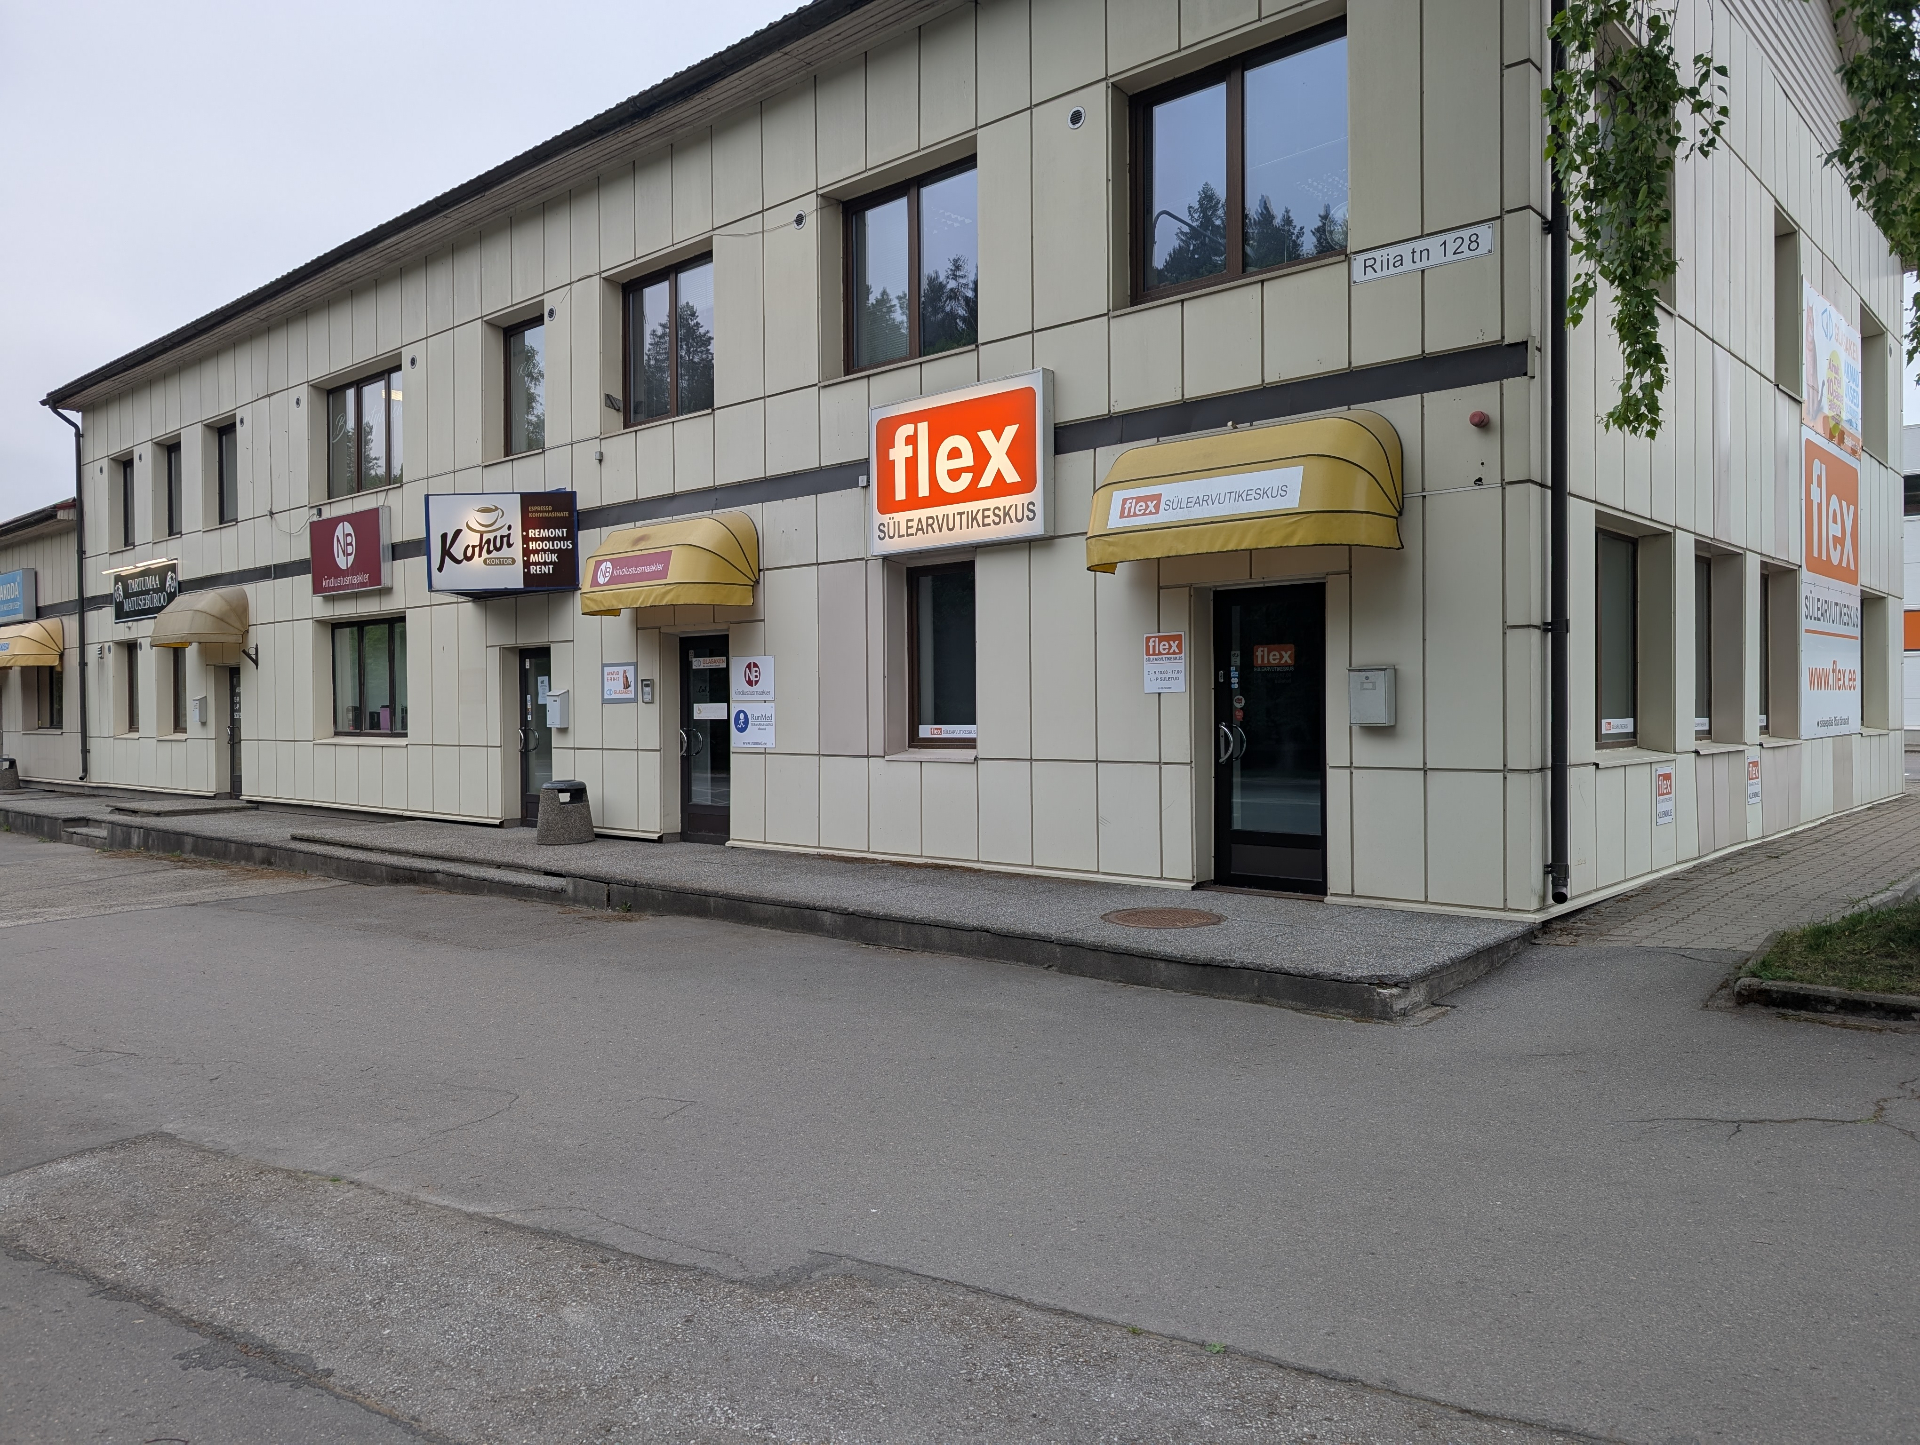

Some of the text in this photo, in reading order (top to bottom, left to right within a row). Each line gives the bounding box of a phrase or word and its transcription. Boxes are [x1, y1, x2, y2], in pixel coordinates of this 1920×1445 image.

[1363, 232, 1480, 276] Riia tn 128
[888, 421, 1022, 501] flex
[1123, 484, 1288, 517] flex SÜLEARVUTIKESKUS
[877, 501, 1037, 541] SÜLEARVUTIKESKUS
[1810, 458, 1855, 571] flex
[528, 528, 568, 538] REMONT
[436, 524, 515, 573] Kohvi
[528, 540, 573, 550] HOOLDUS
[529, 551, 559, 563] MÜÜK
[530, 565, 554, 574] RENT
[127, 574, 161, 593] TARTUMAA
[322, 572, 370, 588] kindlustusmaakler
[123, 591, 168, 612] MATUSEBÜROO
[1804, 590, 1859, 629] SÜLEARVUTIKESKUS
[1148, 637, 1180, 655] flex
[1255, 647, 1293, 664] flex
[1808, 659, 1857, 692] www.flex.ee
[1658, 778, 1671, 794] flex
